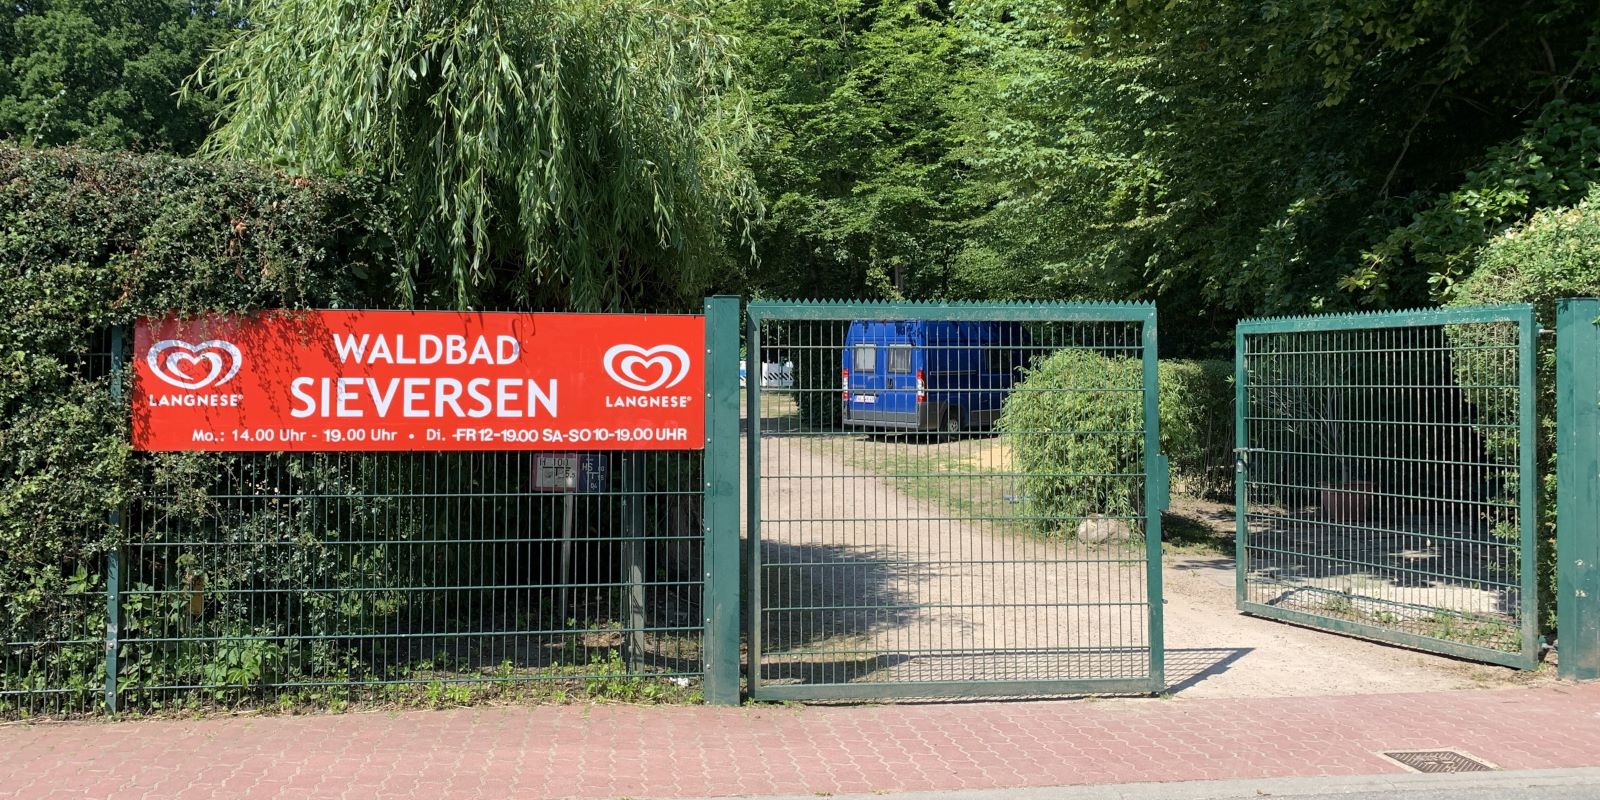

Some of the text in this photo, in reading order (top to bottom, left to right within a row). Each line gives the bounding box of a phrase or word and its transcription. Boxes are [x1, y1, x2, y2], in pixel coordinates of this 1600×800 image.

[332, 333, 520, 366] WALDBAD
[290, 377, 559, 419] SIEVERSEN
[191, 429, 225, 442] Mo.:
[231, 428, 275, 442] 14.00
[279, 428, 307, 442] Uhr
[323, 428, 366, 442] 19.00
[370, 428, 398, 442] Uhr
[426, 428, 446, 441] Di.
[655, 427, 688, 441] UHR
